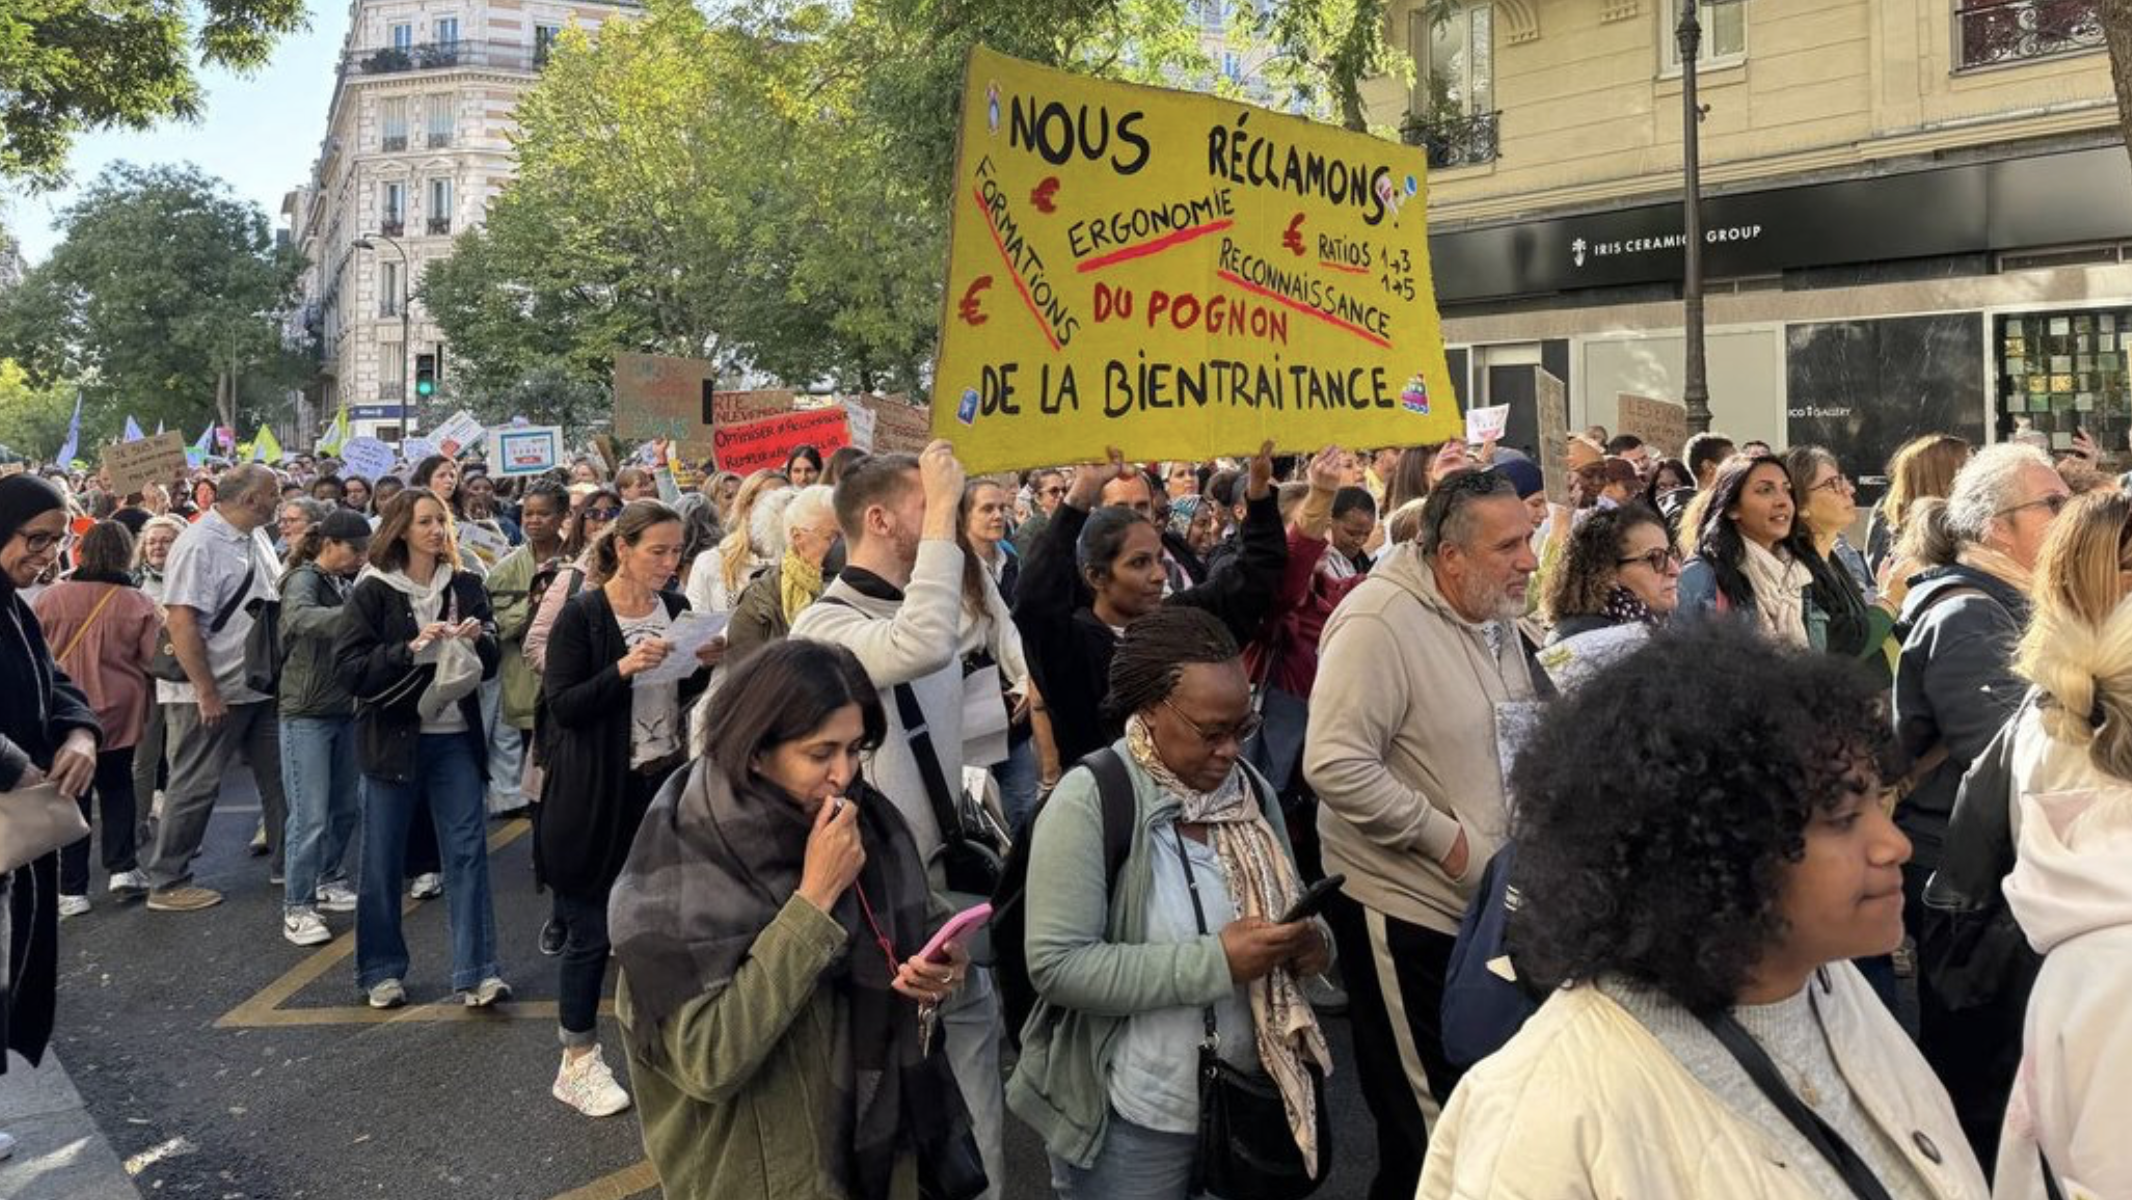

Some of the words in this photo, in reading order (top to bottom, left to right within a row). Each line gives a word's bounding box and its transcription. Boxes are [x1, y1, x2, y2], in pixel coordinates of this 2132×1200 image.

[1010, 95, 1150, 175] NOUS
[975, 155, 1081, 346] FORMATIONS
[1067, 188, 1235, 258] ERGONOMIE
[1319, 233, 1372, 267] RATIOS
[1594, 241, 1622, 256] IRIS
[1706, 225, 1762, 243] GROUP
[1093, 282, 1133, 324] DU
[1147, 289, 1288, 346] POGNON
[1219, 237, 1391, 340] RECONNAISSANCE
[978, 363, 1020, 415] DE
[1040, 364, 1080, 415] LA
[1103, 350, 1395, 418] BIENTRAITANCE
